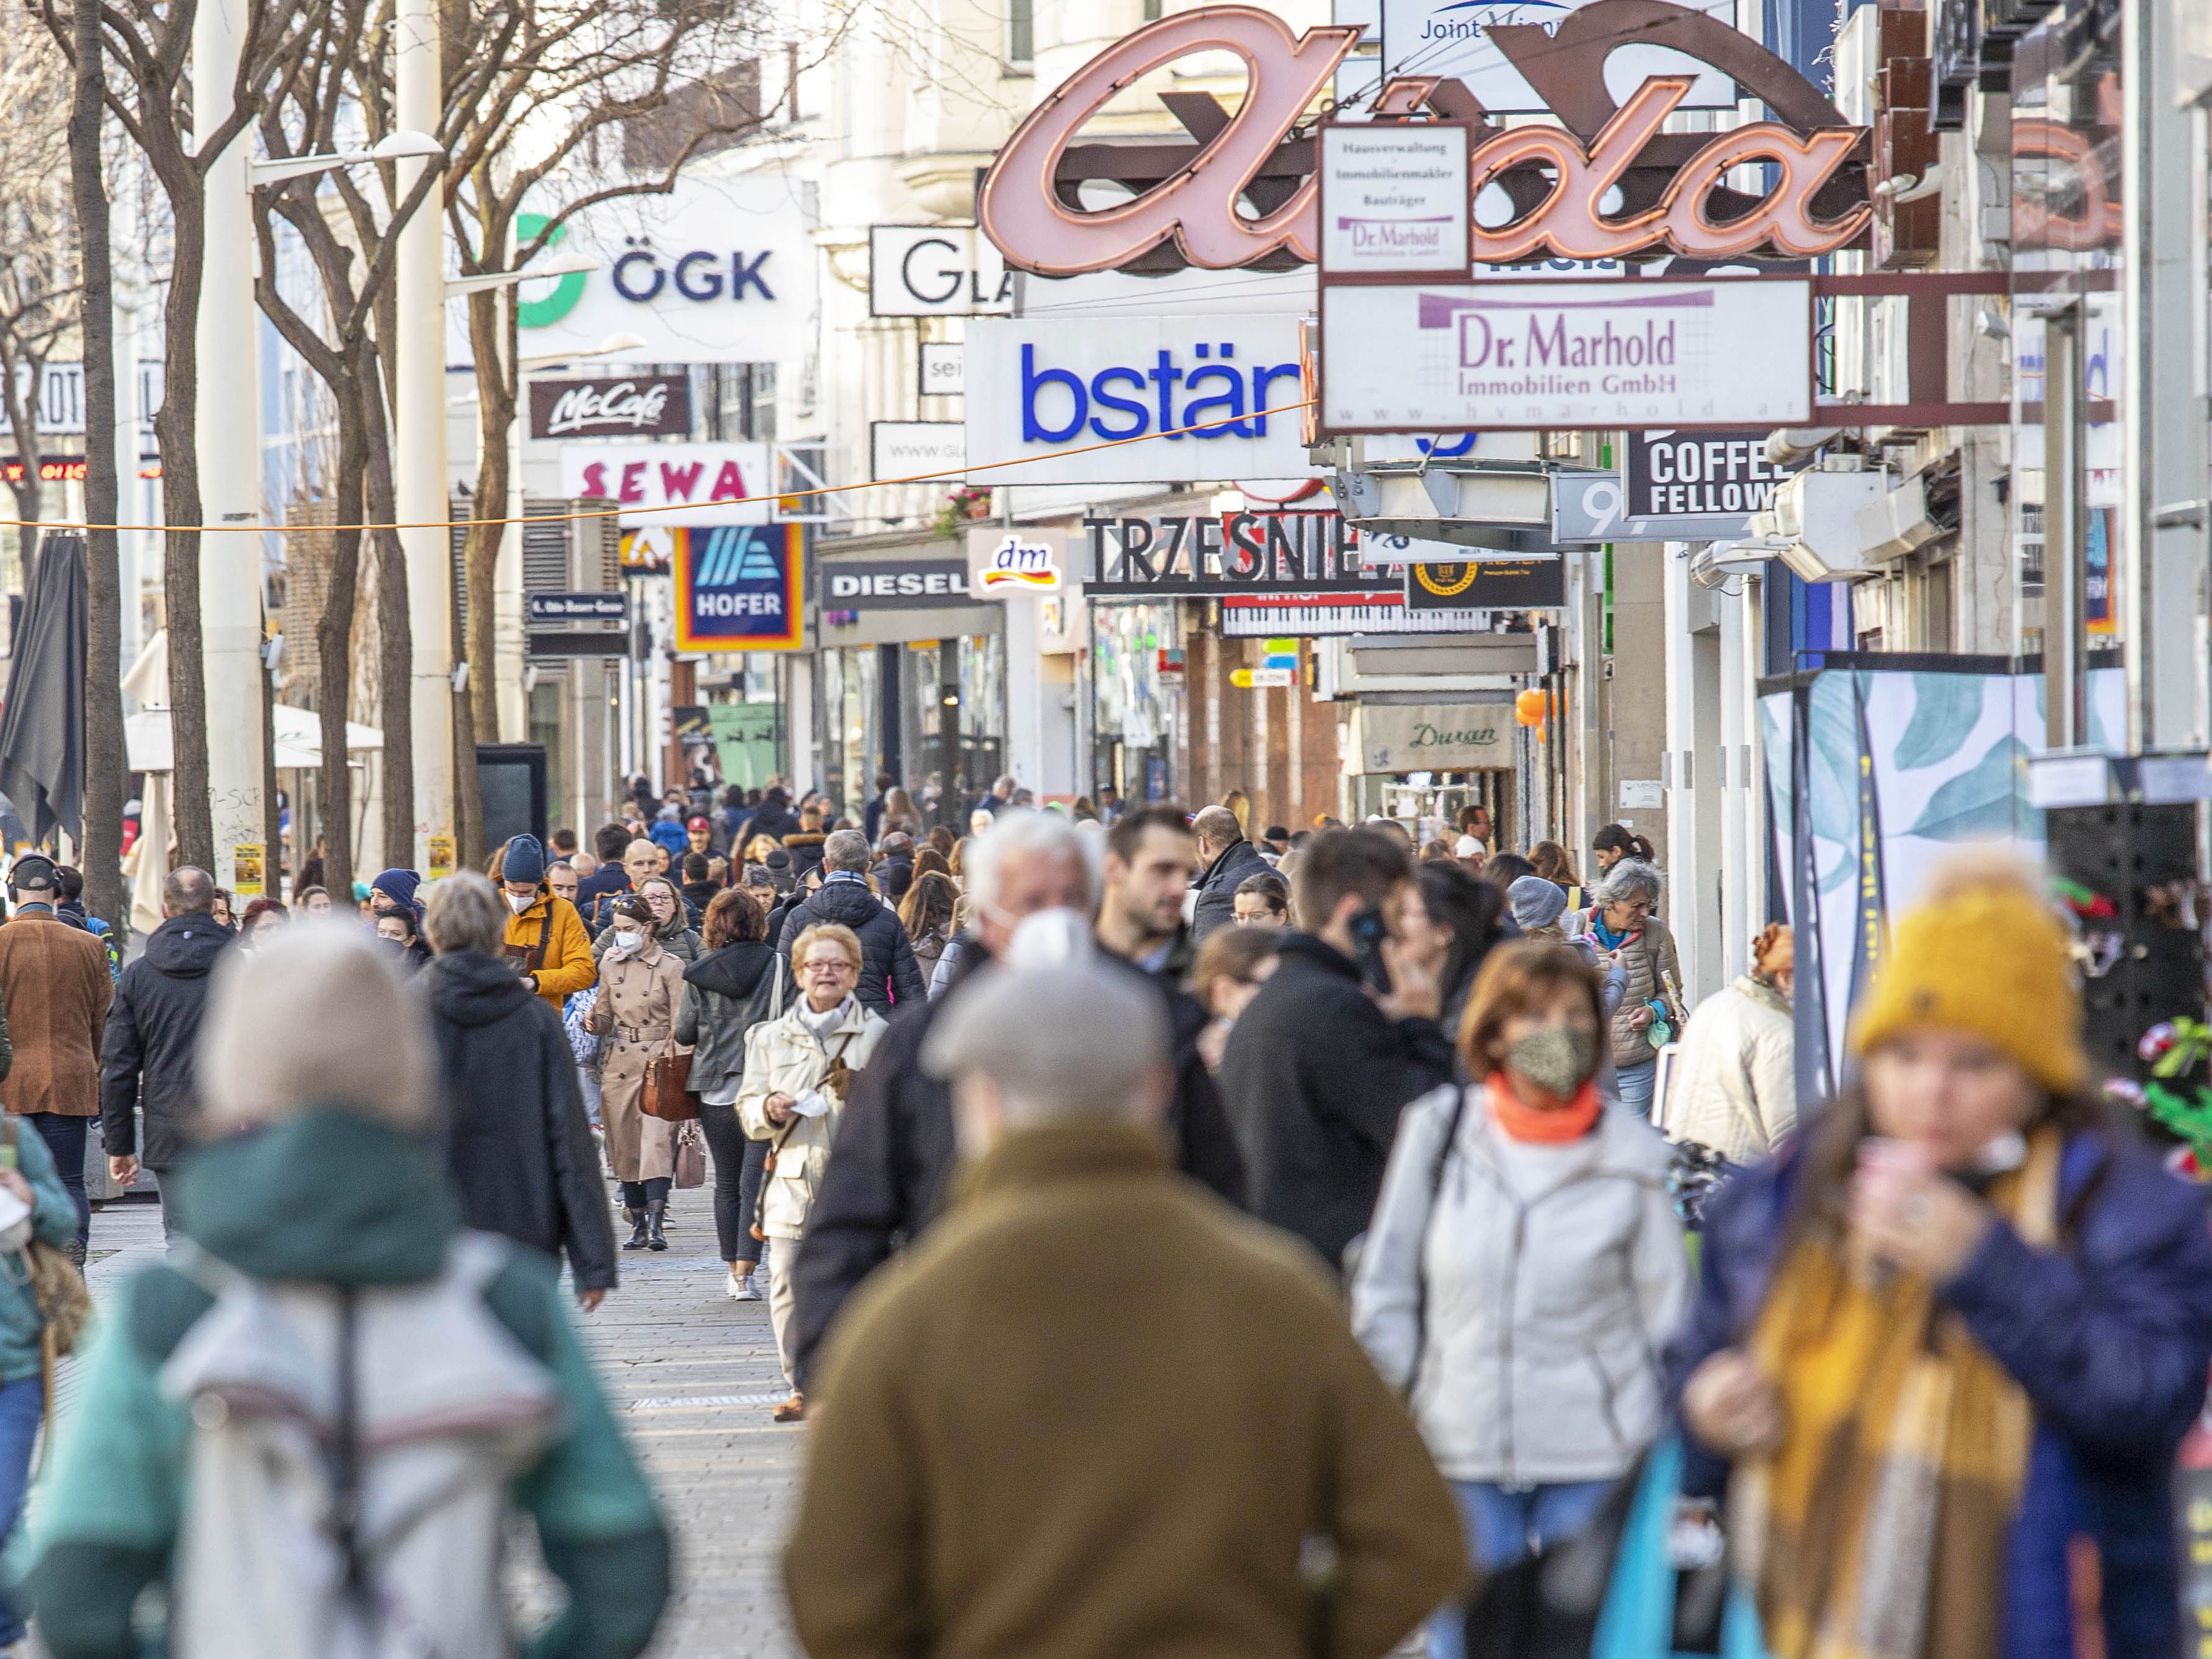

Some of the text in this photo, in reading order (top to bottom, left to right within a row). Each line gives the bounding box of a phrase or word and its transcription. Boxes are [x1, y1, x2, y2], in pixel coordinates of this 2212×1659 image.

[1420, 20, 1481, 38] Joint
[1342, 142, 1447, 156] Hausverwaltung
[1336, 168, 1453, 180] Immobilienmakler
[1363, 194, 1426, 209] Bauträger
[1381, 223, 1440, 246] Marhold
[612, 236, 776, 302] ÖGK
[1459, 313, 1675, 367] Dr. Marhold
[1459, 373, 1676, 396] Immobilien GmbH
[1649, 440, 1797, 484] COFFE
[582, 461, 748, 505] SEWA
[997, 540, 1047, 568] dm
[1083, 513, 1393, 583] TRZESNIE
[831, 573, 970, 597] DIESEL
[696, 592, 783, 617] HOFER
[1409, 722, 1498, 748] Duran
